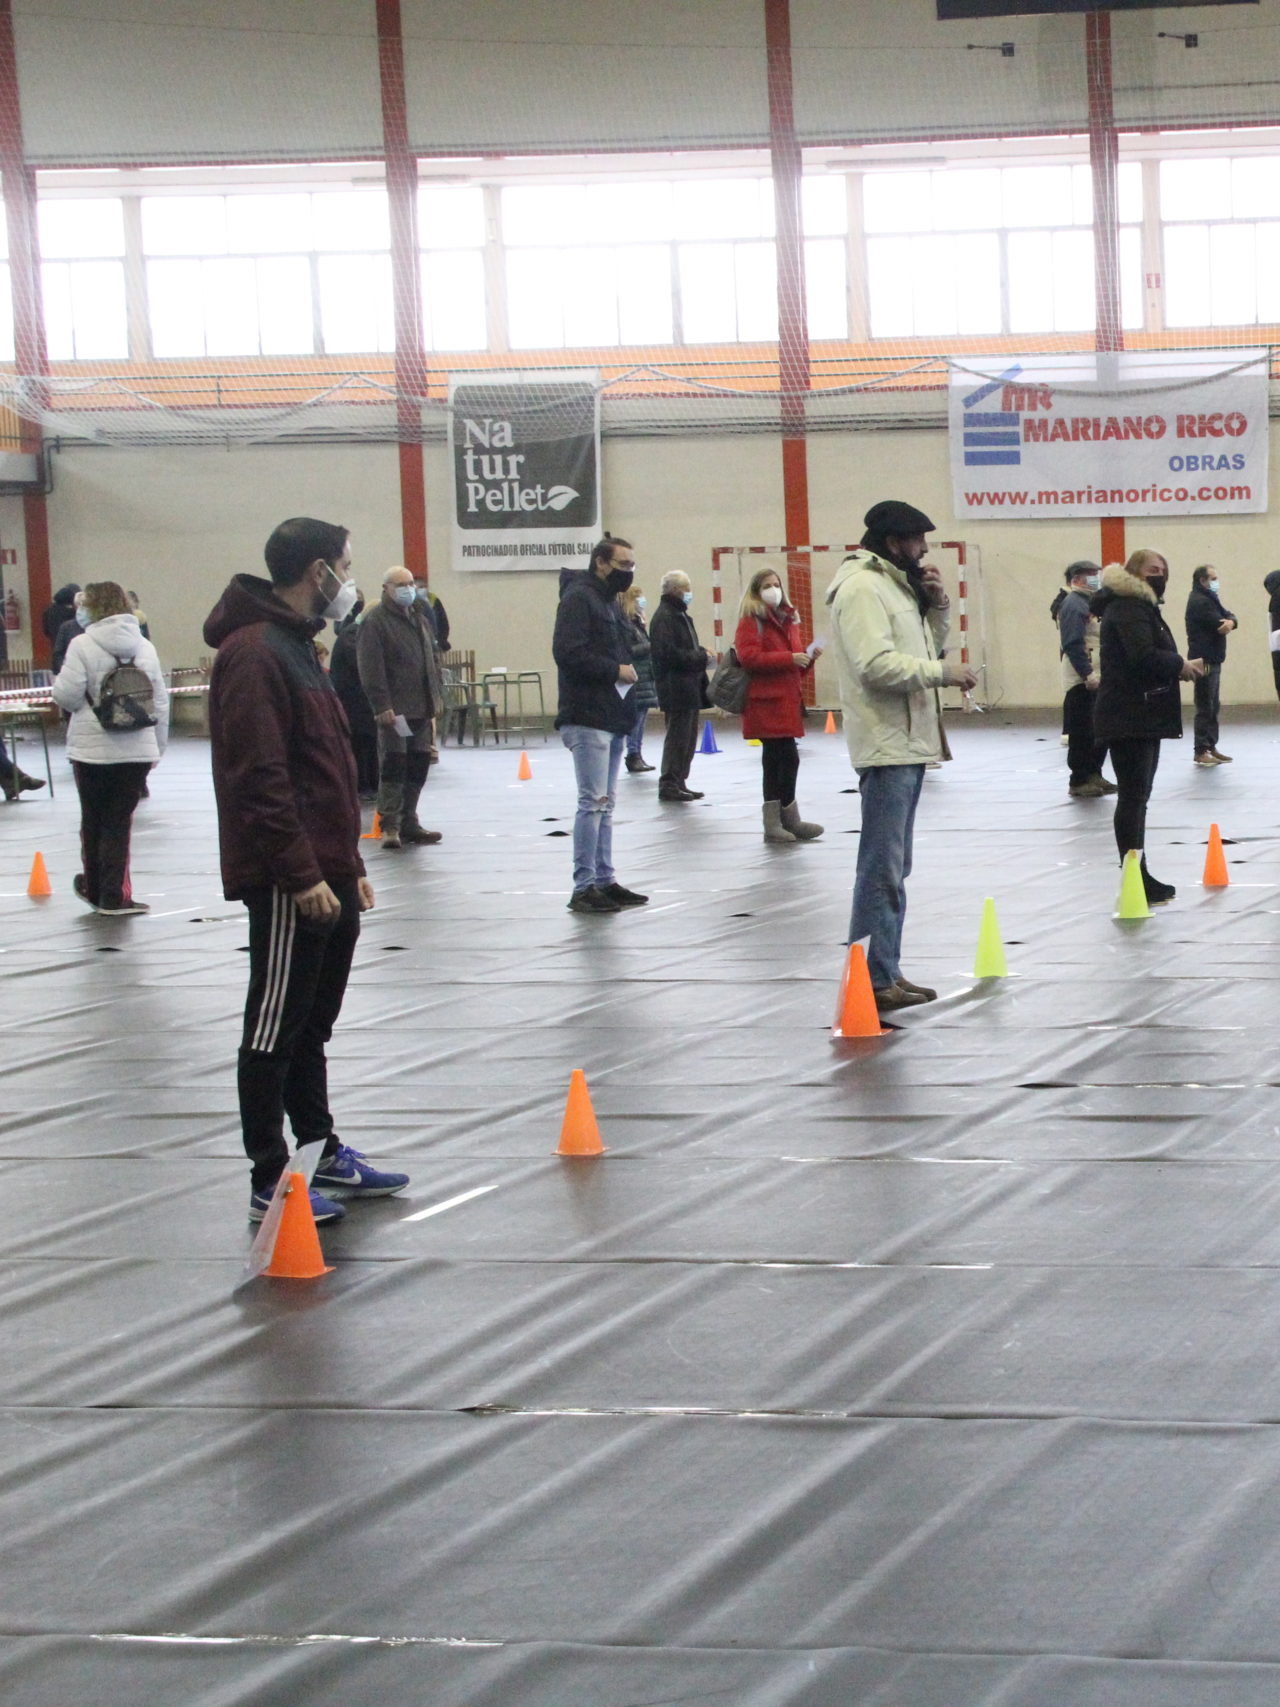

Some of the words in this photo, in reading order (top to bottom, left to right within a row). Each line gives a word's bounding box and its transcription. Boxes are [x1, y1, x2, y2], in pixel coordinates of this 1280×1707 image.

[463, 418, 514, 448] Na
[1023, 415, 1167, 443] MARIANO
[1176, 412, 1248, 439] RICO
[464, 449, 525, 480] tur
[1168, 453, 1246, 473] OBRAS
[465, 481, 549, 512] Pellet
[964, 484, 1252, 506] www.marianorico.com
[462, 544, 518, 557] PATROCINADOR
[520, 543, 547, 556] OFICIAL
